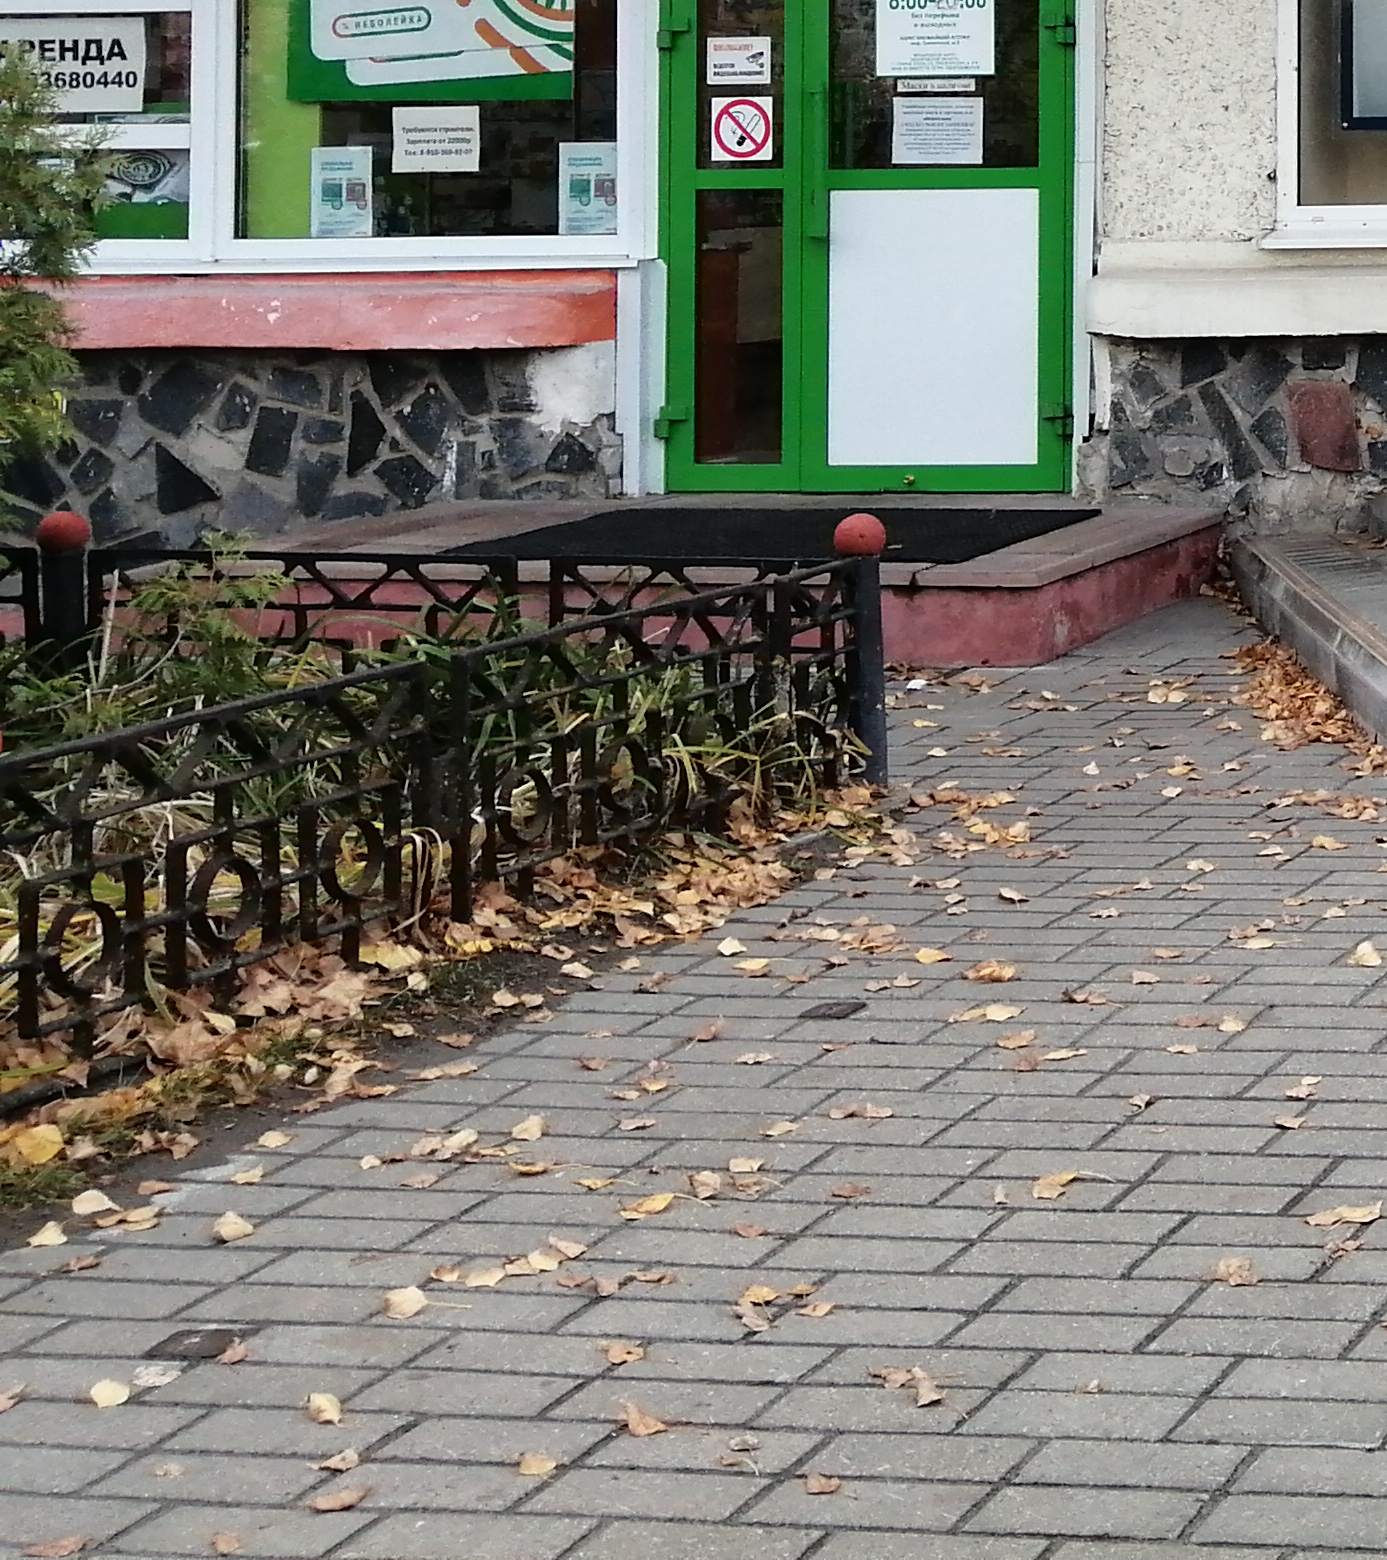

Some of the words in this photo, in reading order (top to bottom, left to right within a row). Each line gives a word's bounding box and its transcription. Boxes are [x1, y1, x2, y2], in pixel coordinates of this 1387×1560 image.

[354, 14, 423, 30] НЕБОЛЕЙКА
[0, 38, 128, 66] РЕНДА
[901, 82, 929, 90] Маски
